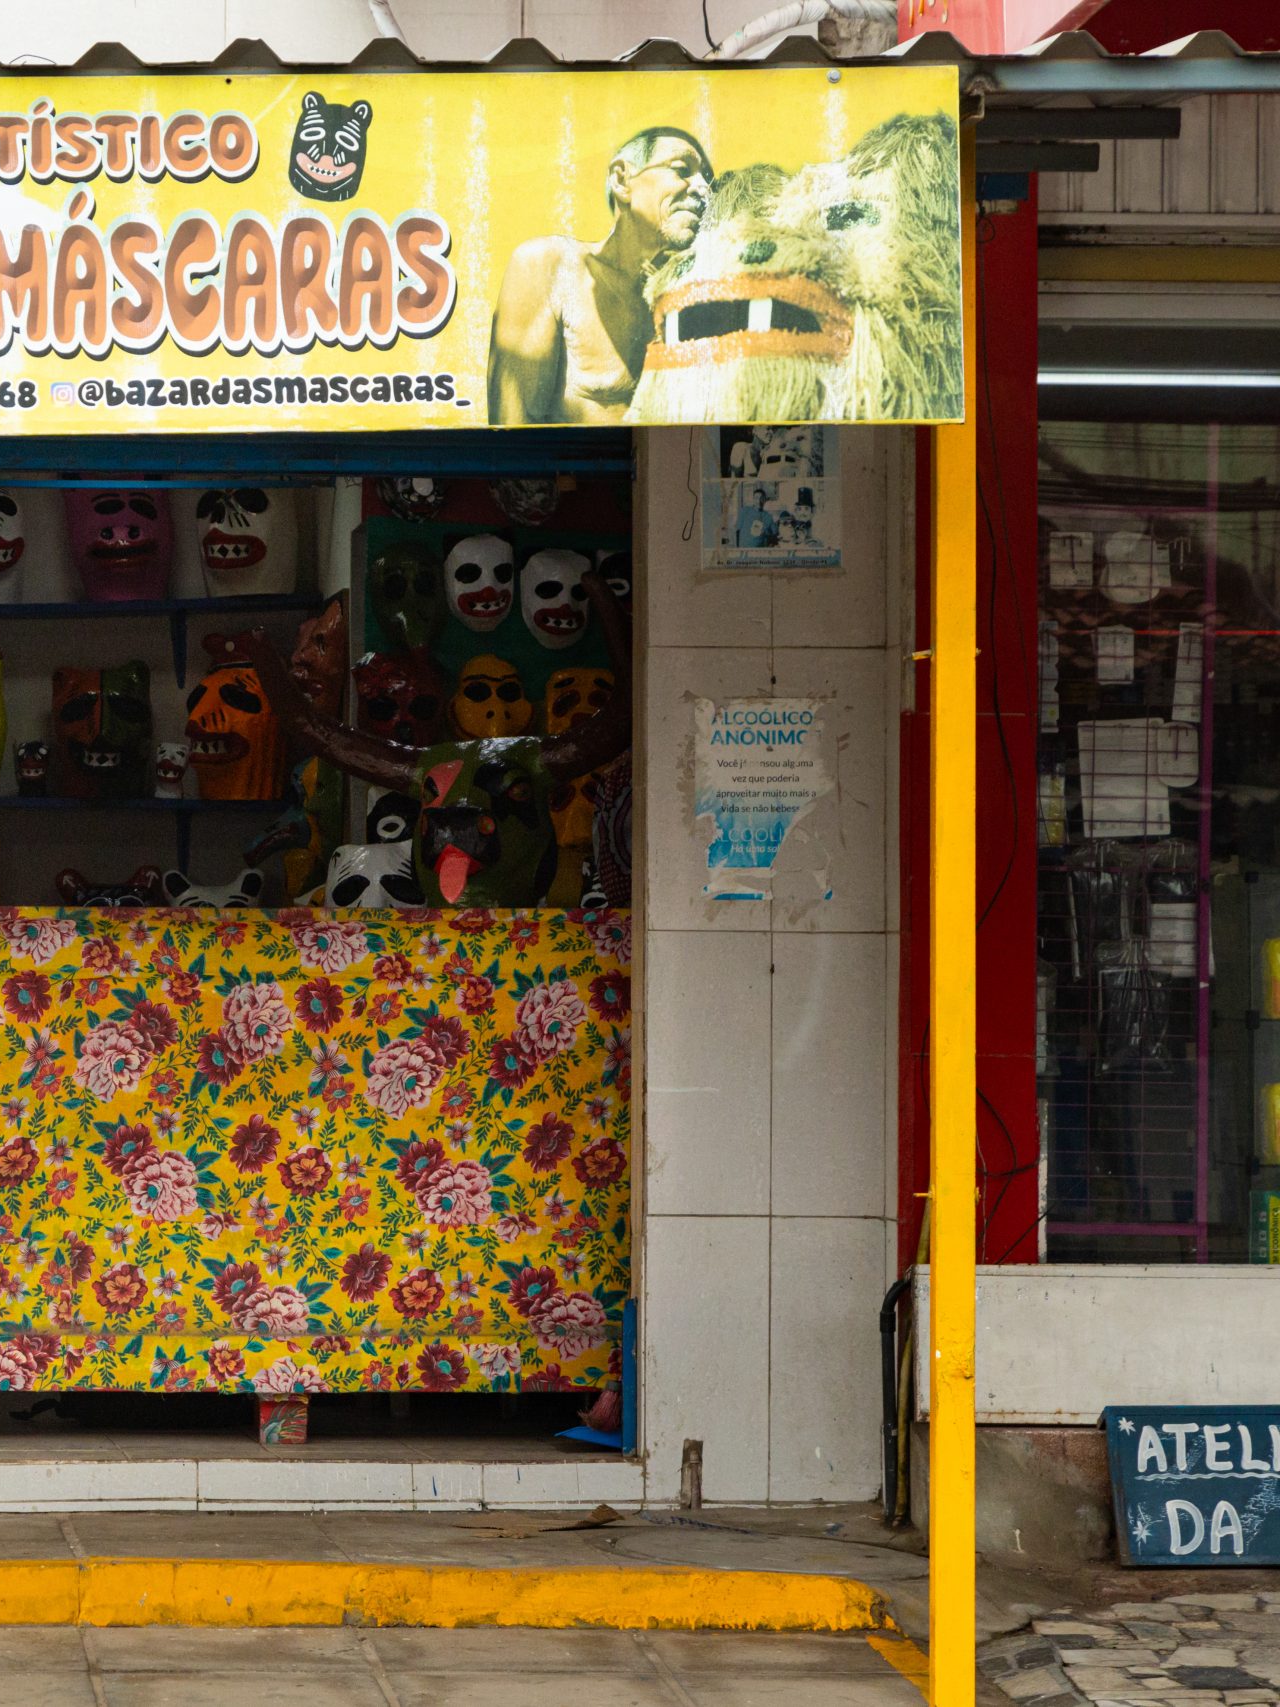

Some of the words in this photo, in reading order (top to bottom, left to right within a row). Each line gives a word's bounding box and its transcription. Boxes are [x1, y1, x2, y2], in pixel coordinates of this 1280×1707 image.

[717, 759, 738, 768] Você
[748, 776, 765, 784] que
[766, 774, 800, 784] poderia
[716, 789, 760, 799] aproveitar
[762, 789, 788, 798] muito
[789, 789, 812, 798] mais
[721, 804, 740, 812] vida
[753, 804, 769, 812] não
[1165, 1499, 1244, 1555] DA
